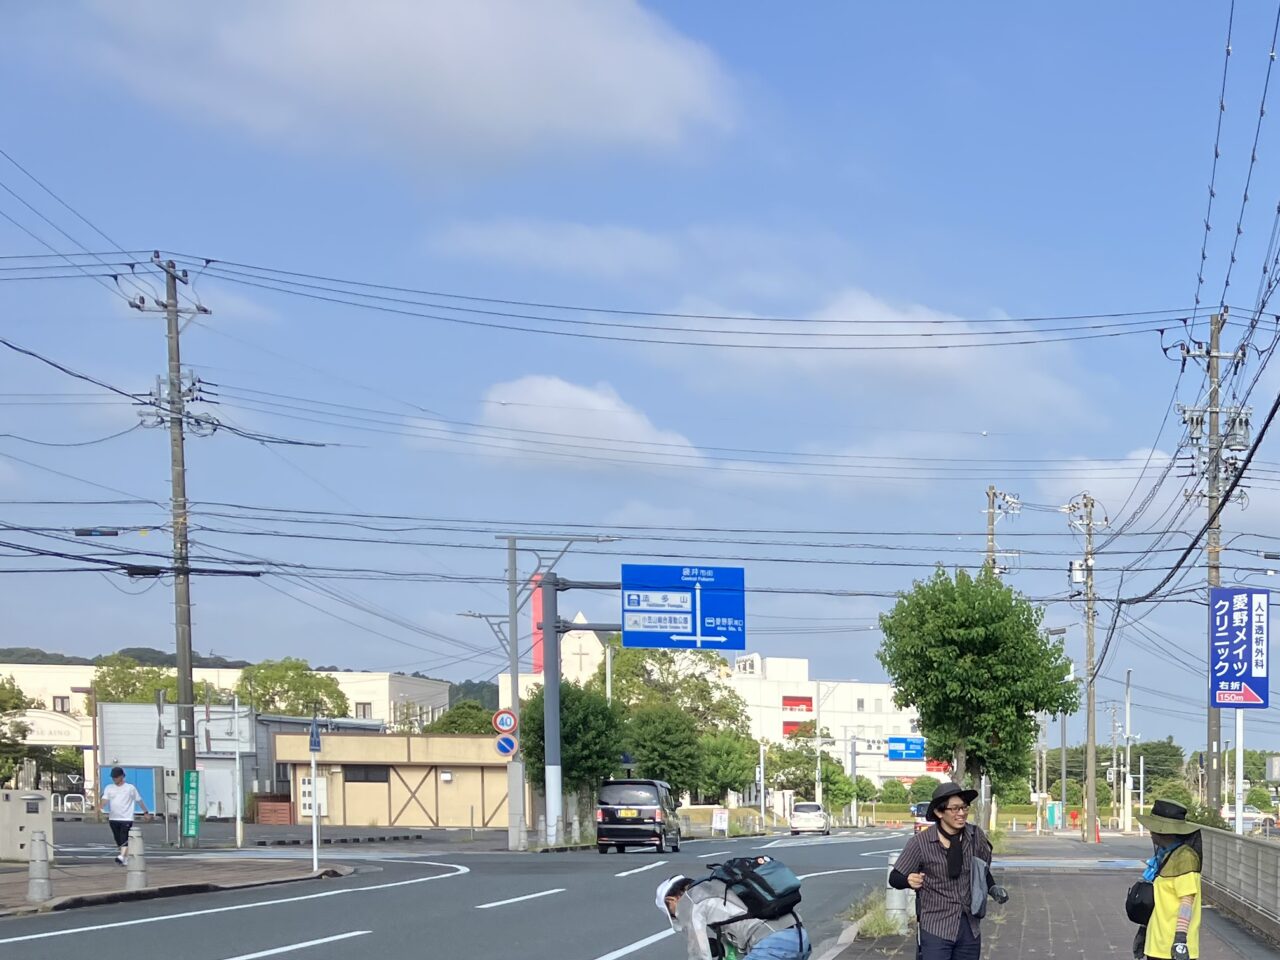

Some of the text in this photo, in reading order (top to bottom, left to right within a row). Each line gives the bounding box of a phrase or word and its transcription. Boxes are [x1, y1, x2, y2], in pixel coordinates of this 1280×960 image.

[1214, 599, 1230, 677] クリニック
[1232, 593, 1248, 677] 愛野メイツ
[1254, 601, 1265, 670] 人工透析外科
[1218, 681, 1241, 690] 右折
[1219, 693, 1244, 702] 150m
[499, 716, 512, 727] 40
